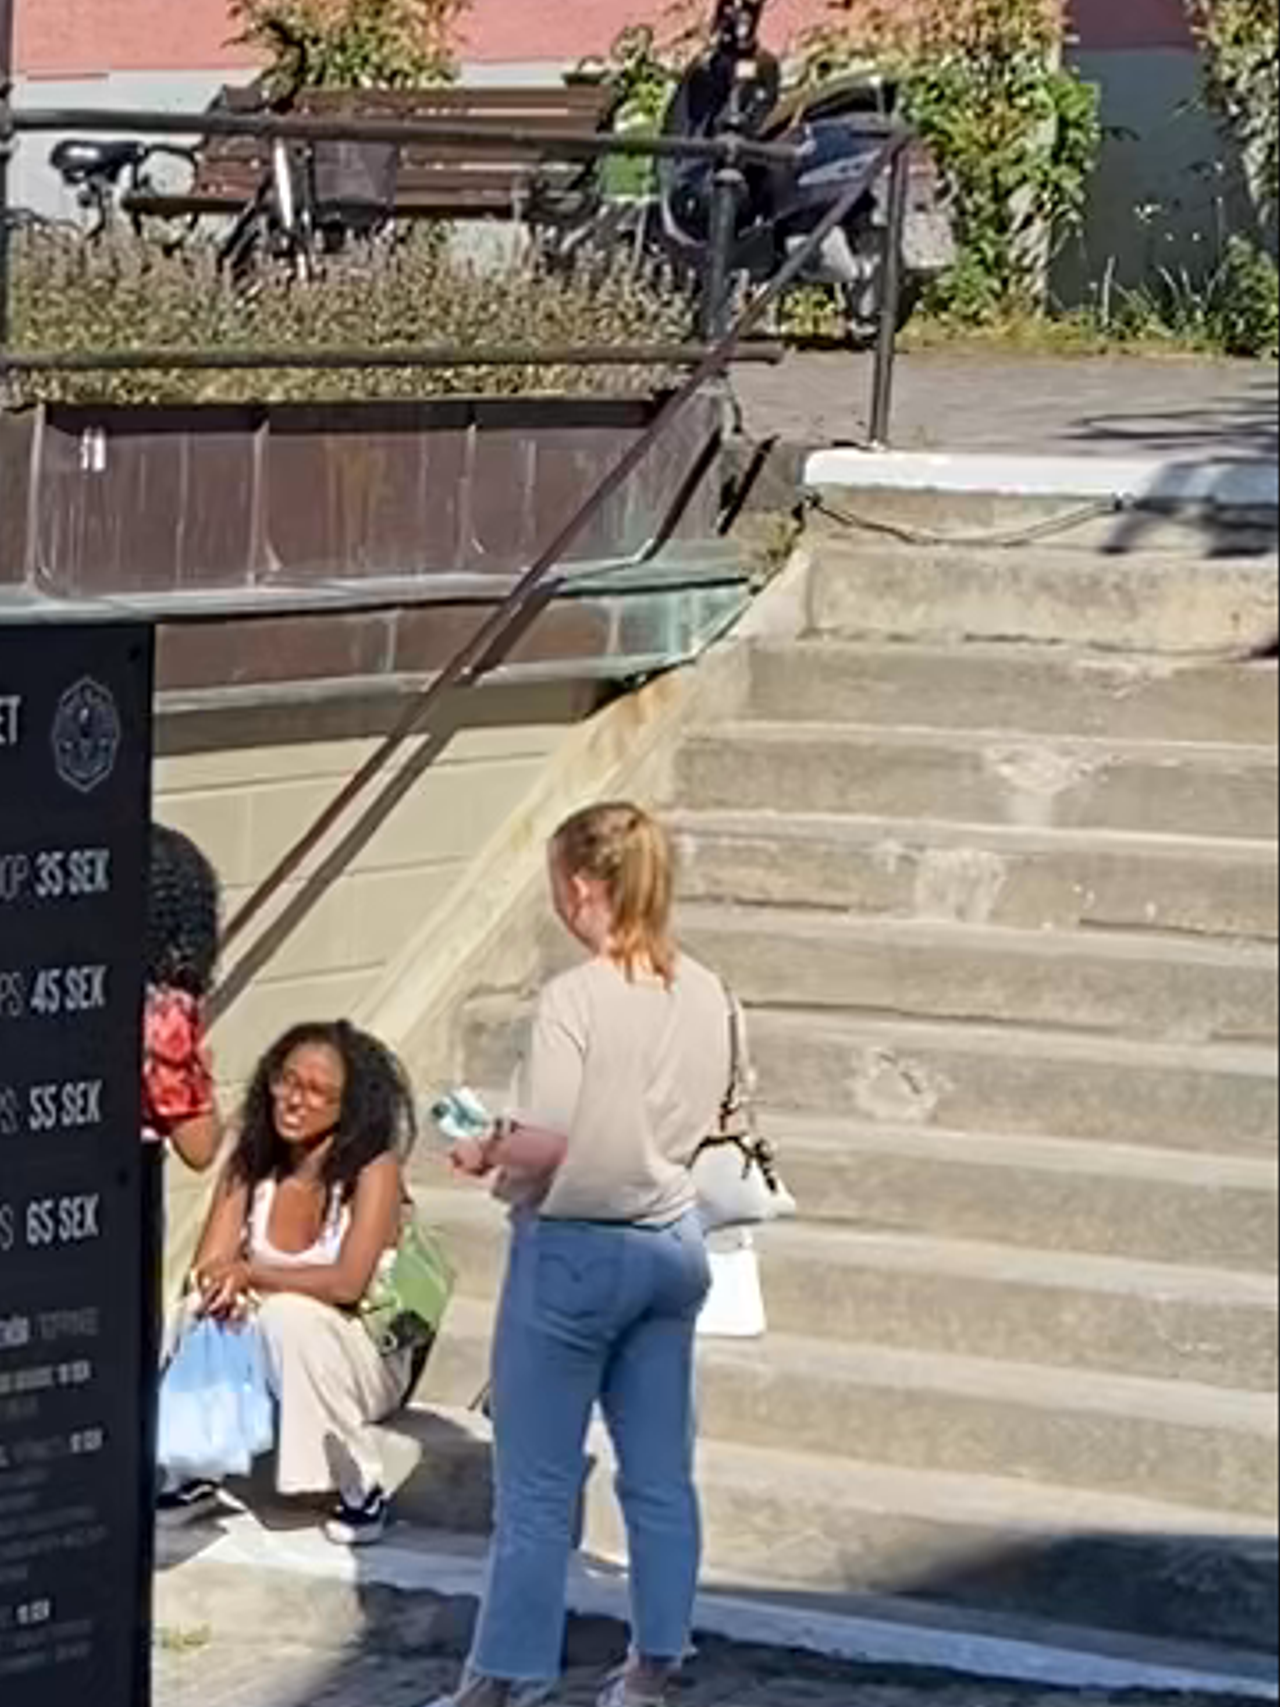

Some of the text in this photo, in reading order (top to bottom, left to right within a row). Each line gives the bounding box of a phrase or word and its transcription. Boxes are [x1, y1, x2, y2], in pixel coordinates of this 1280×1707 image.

[34, 849, 65, 897] 35
[66, 847, 111, 894] SEK
[30, 967, 62, 1014] 45
[64, 964, 109, 1011] SEK
[29, 1085, 58, 1131] 55
[61, 1078, 103, 1126] SEK
[25, 1199, 55, 1246] 65
[58, 1193, 101, 1241] SEK
